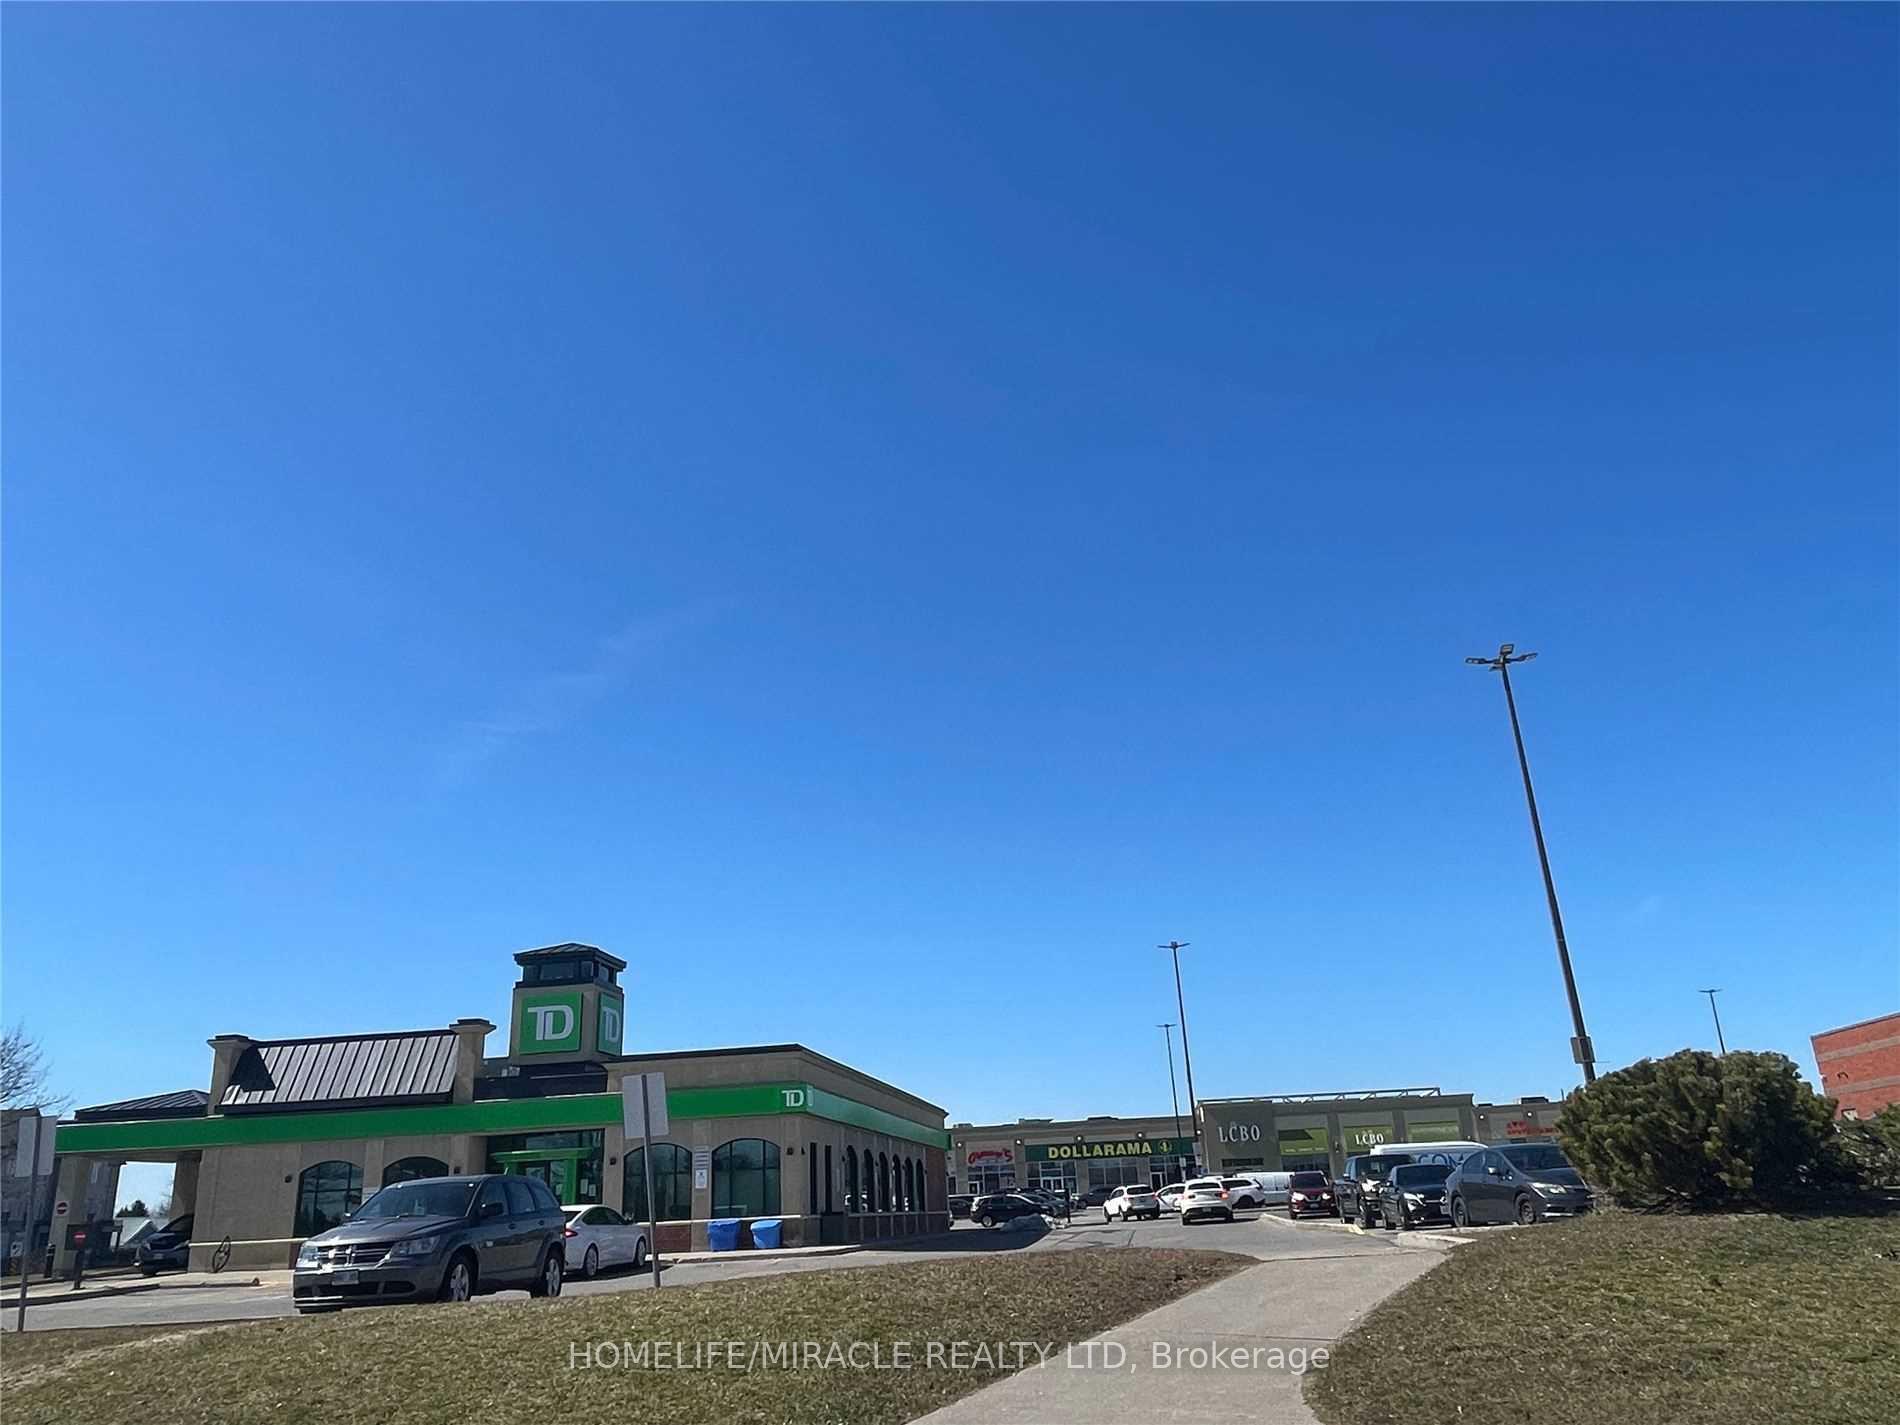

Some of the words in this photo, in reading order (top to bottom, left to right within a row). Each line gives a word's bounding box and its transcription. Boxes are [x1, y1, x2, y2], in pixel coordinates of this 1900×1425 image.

[527, 1005, 574, 1040] TD
[602, 1006, 620, 1042] TD
[781, 1089, 804, 1107] TD
[1218, 1123, 1261, 1143] LCBO
[1355, 1132, 1385, 1146] LCBO
[1047, 1141, 1153, 1159] DOLLARAMA
